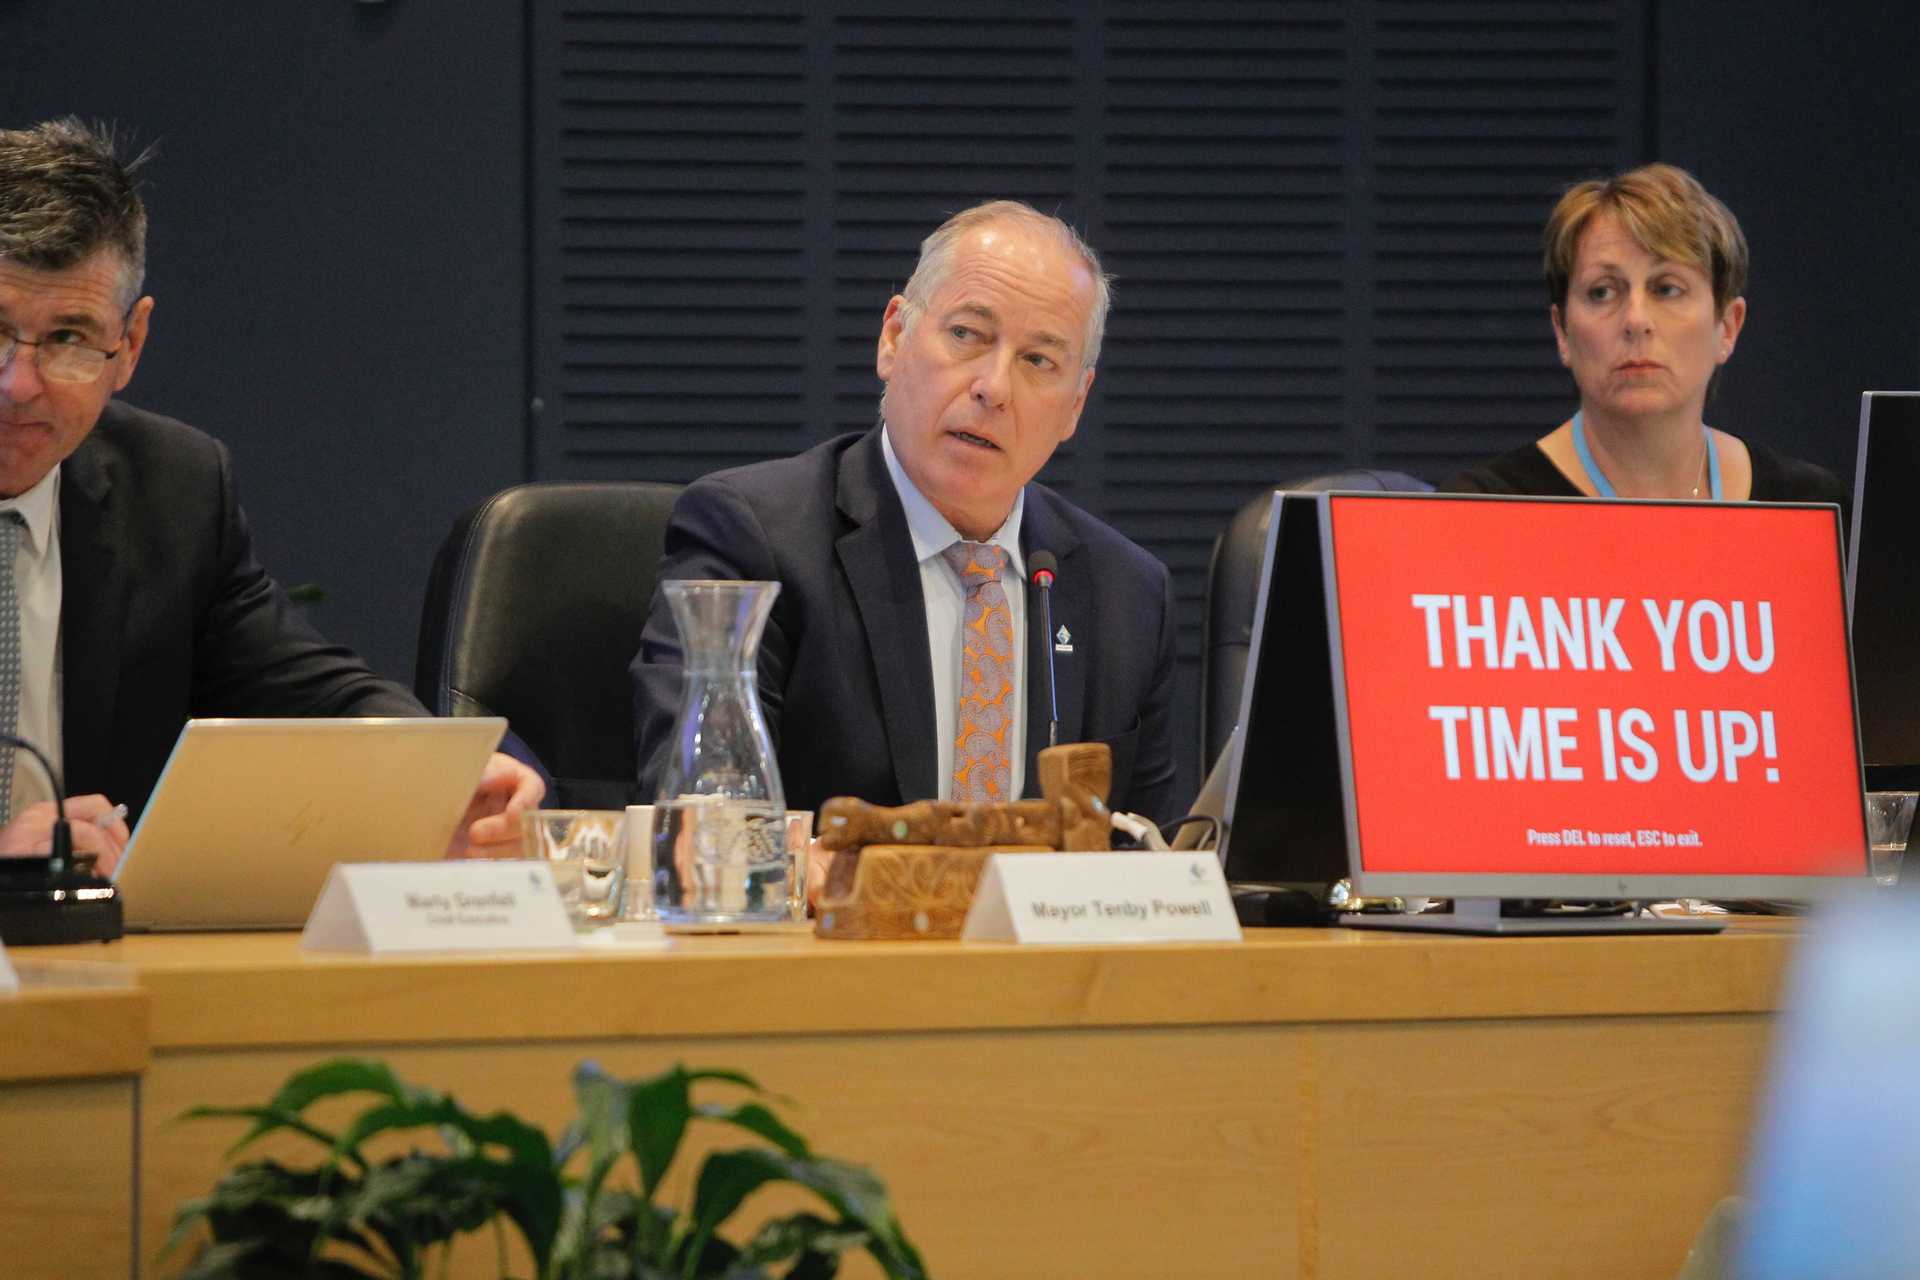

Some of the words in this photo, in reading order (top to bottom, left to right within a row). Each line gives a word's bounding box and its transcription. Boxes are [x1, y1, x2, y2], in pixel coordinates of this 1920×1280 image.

[1412, 594, 1632, 671] THANK
[1642, 598, 1774, 673] YOU
[1429, 706, 1583, 780] TIME
[1598, 708, 1658, 782] IS
[1674, 710, 1779, 783] UP!
[1527, 829, 1561, 846] Press
[1562, 830, 1585, 846] DEL
[1588, 831, 1600, 846] to
[1602, 832, 1636, 848] reset,
[1637, 831, 1662, 847] ESC
[1663, 832, 1675, 847] to
[1678, 831, 1702, 847] exit.
[1031, 901, 1088, 921] Mayor
[1093, 900, 1148, 920] Tenby
[1153, 900, 1213, 918] Powell
